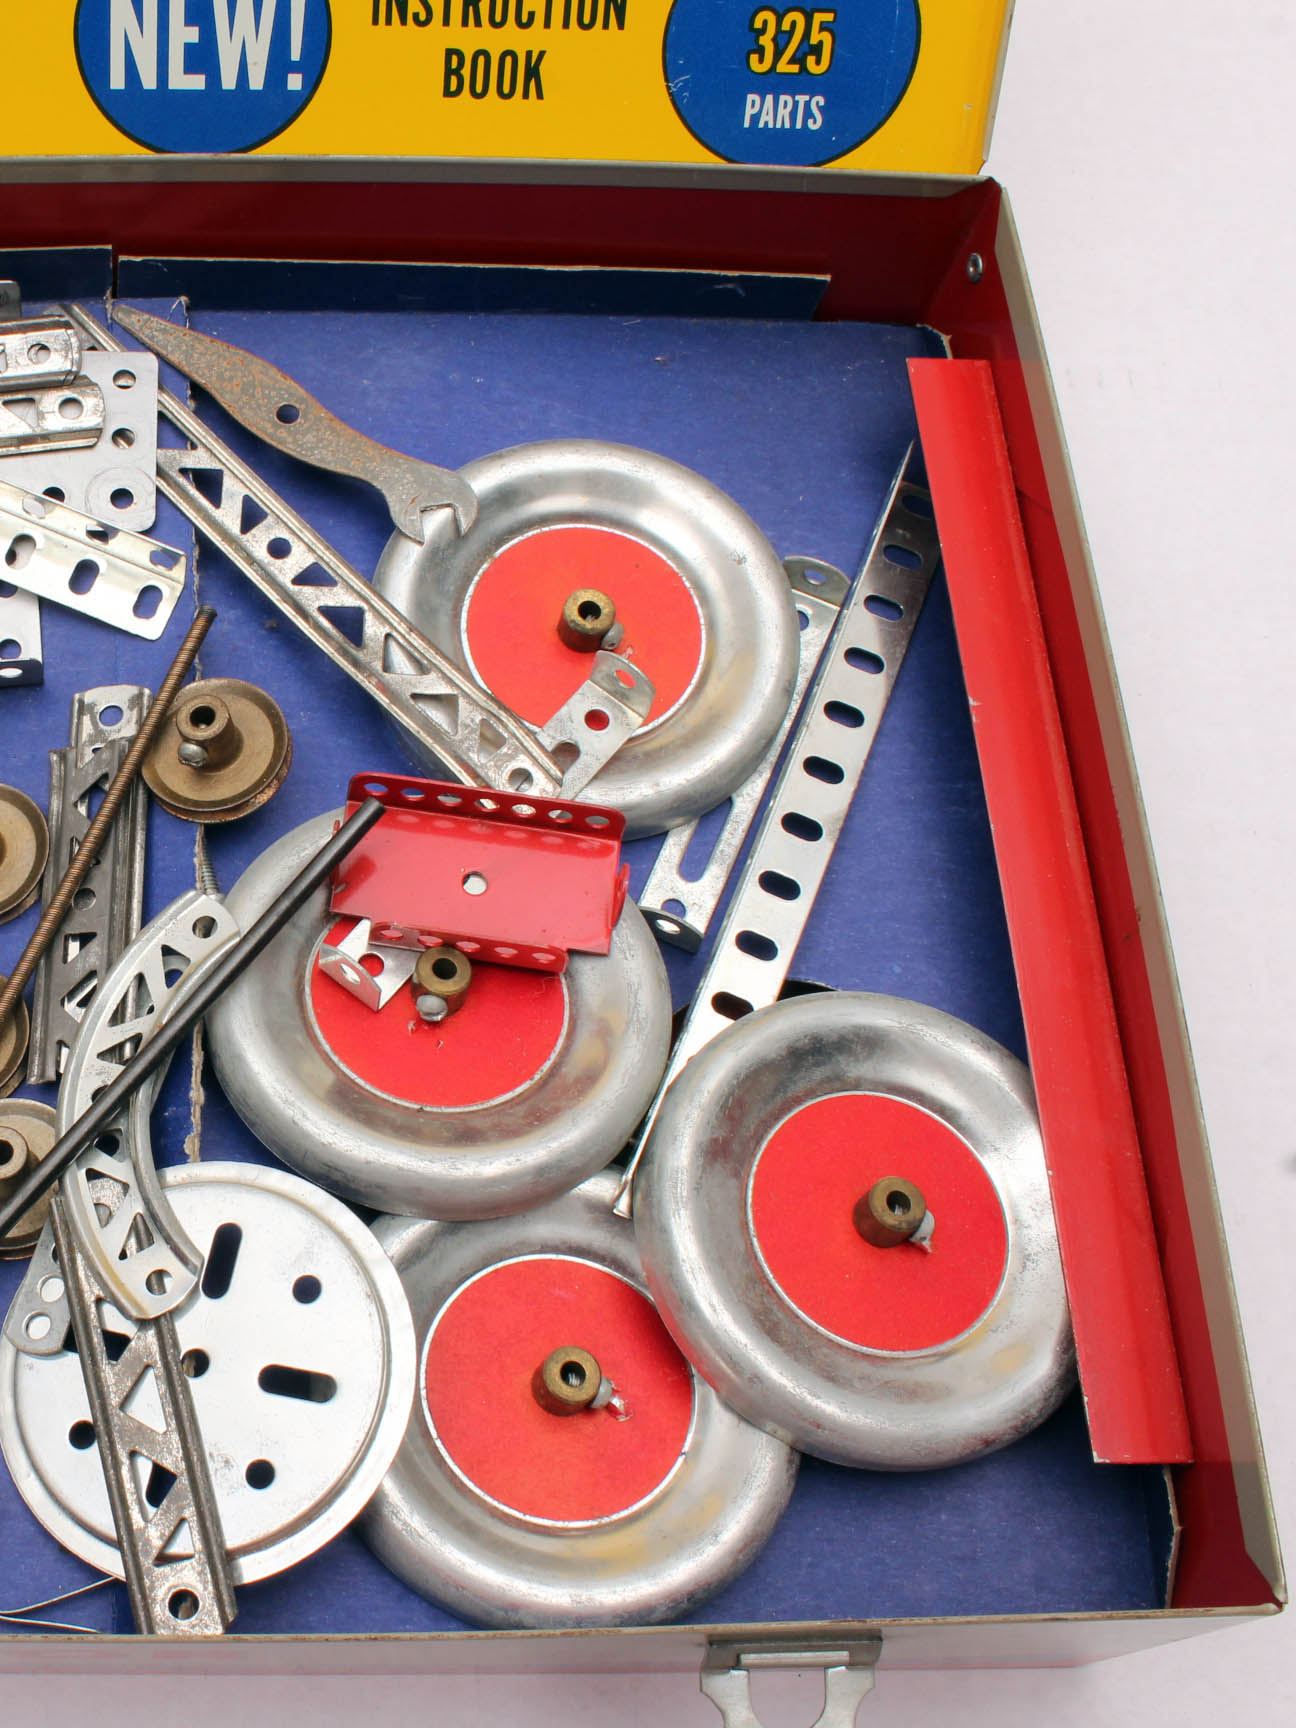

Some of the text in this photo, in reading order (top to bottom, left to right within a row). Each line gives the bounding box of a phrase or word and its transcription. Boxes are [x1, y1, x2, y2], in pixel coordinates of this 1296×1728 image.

[109, 0, 306, 91] NEW!
[746, 7, 838, 76] 325
[442, 47, 547, 101] BOOK
[743, 93, 825, 131] PARTS
